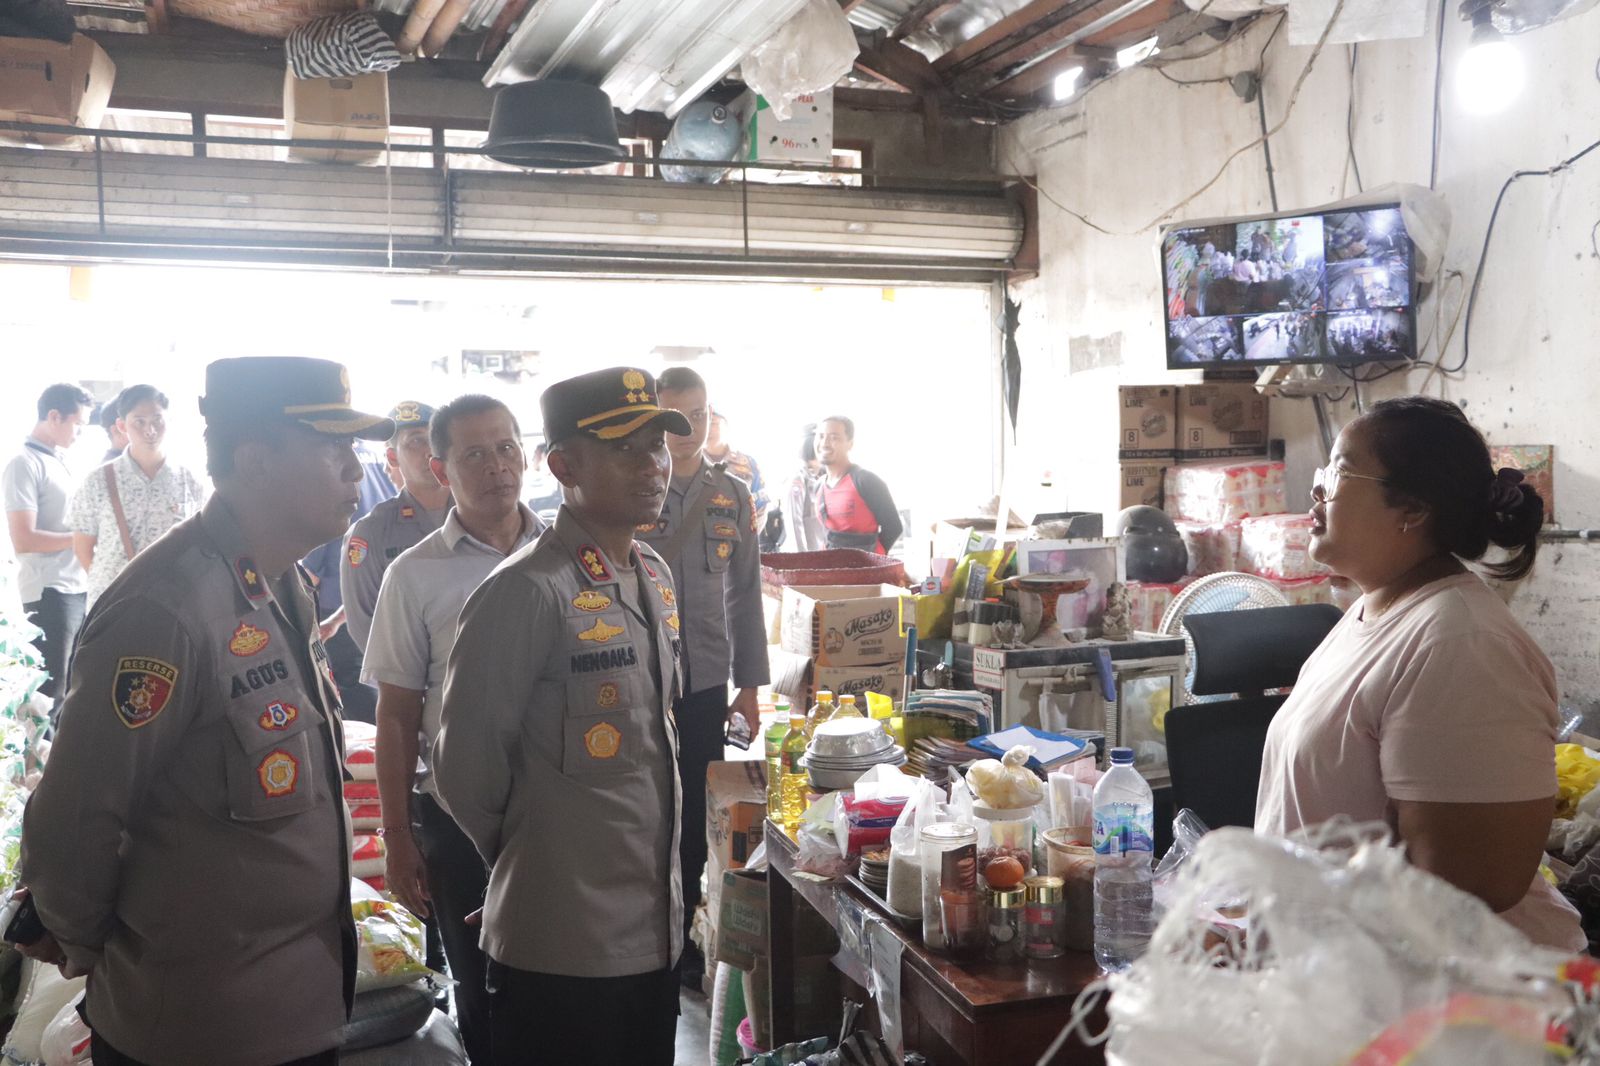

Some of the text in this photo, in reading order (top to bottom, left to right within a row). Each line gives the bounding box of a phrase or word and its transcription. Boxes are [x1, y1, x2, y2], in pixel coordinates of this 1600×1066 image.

[1125, 399, 1144, 408] LIME
[1128, 431, 1135, 442] 8
[1193, 430, 1199, 442] 8
[1126, 477, 1145, 488] LIME
[845, 608, 893, 638] Masako
[976, 652, 1001, 671] SUKLA
[123, 660, 174, 679] RESERSE
[230, 659, 289, 699] AGUS
